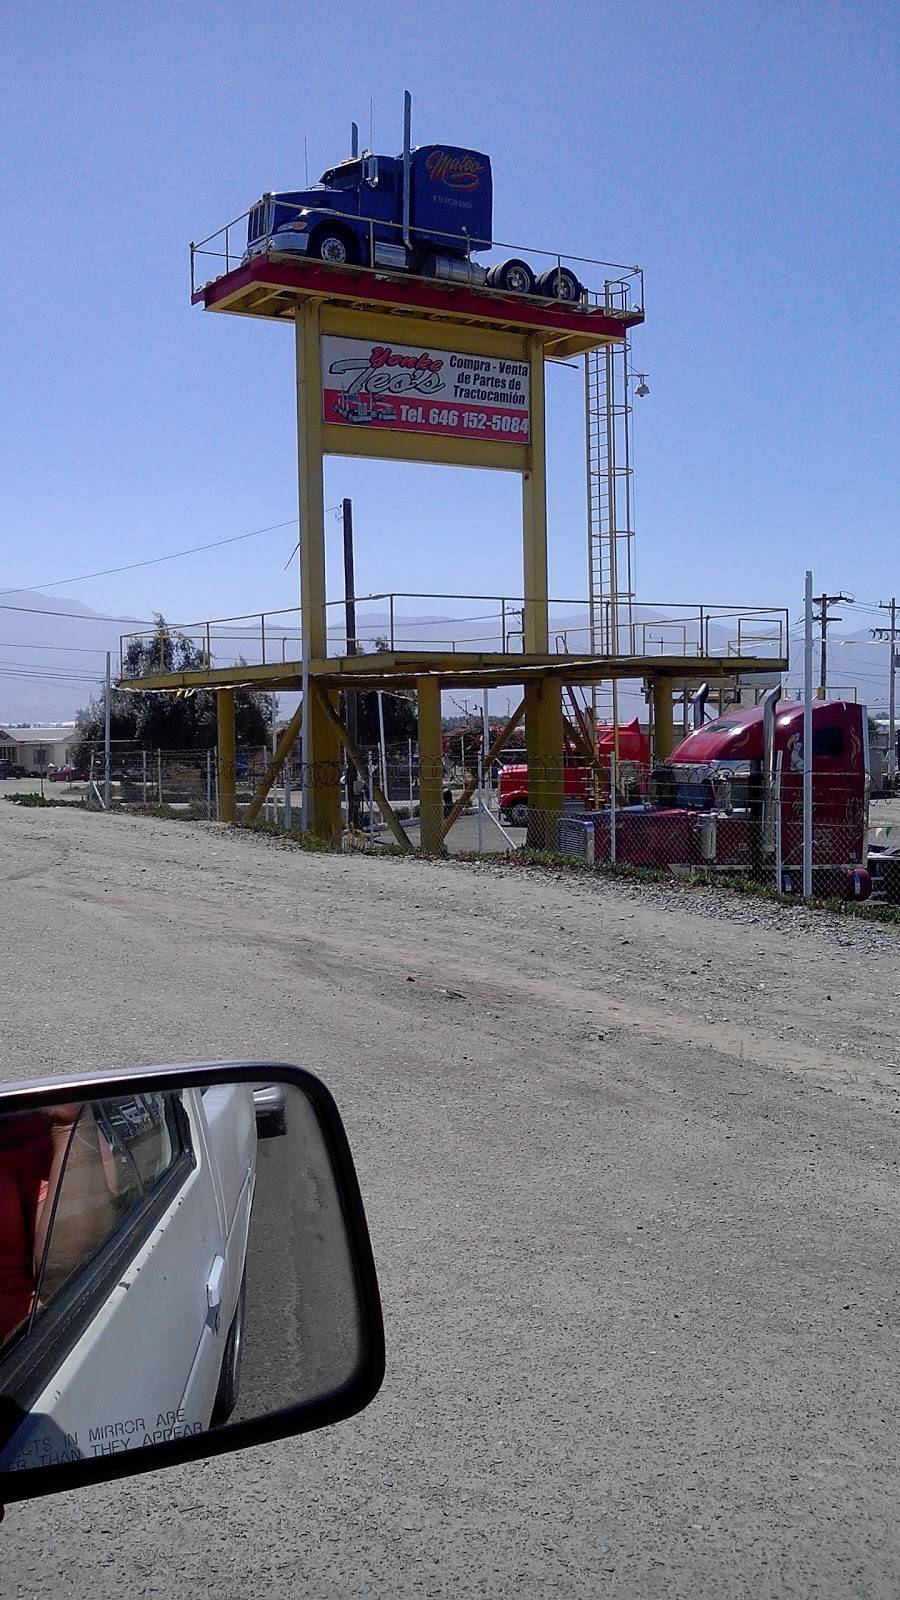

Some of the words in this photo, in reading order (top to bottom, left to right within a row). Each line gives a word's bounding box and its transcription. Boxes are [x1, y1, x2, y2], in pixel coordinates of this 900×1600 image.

[370, 346, 444, 373] Yonke
[449, 355, 491, 371] Compra
[499, 361, 528, 376] Venta
[329, 358, 445, 394] Teo's
[457, 372, 471, 384] de
[473, 373, 507, 388] Partes
[508, 378, 521, 390] de
[453, 384, 526, 404] Tractocamión
[400, 404, 426, 424] Tel.
[429, 408, 459, 426] 646
[462, 412, 529, 433] 152-5084
[64, 1432, 78, 1449] IN
[88, 1418, 145, 1442] MIRROR
[156, 1410, 186, 1427] ARE
